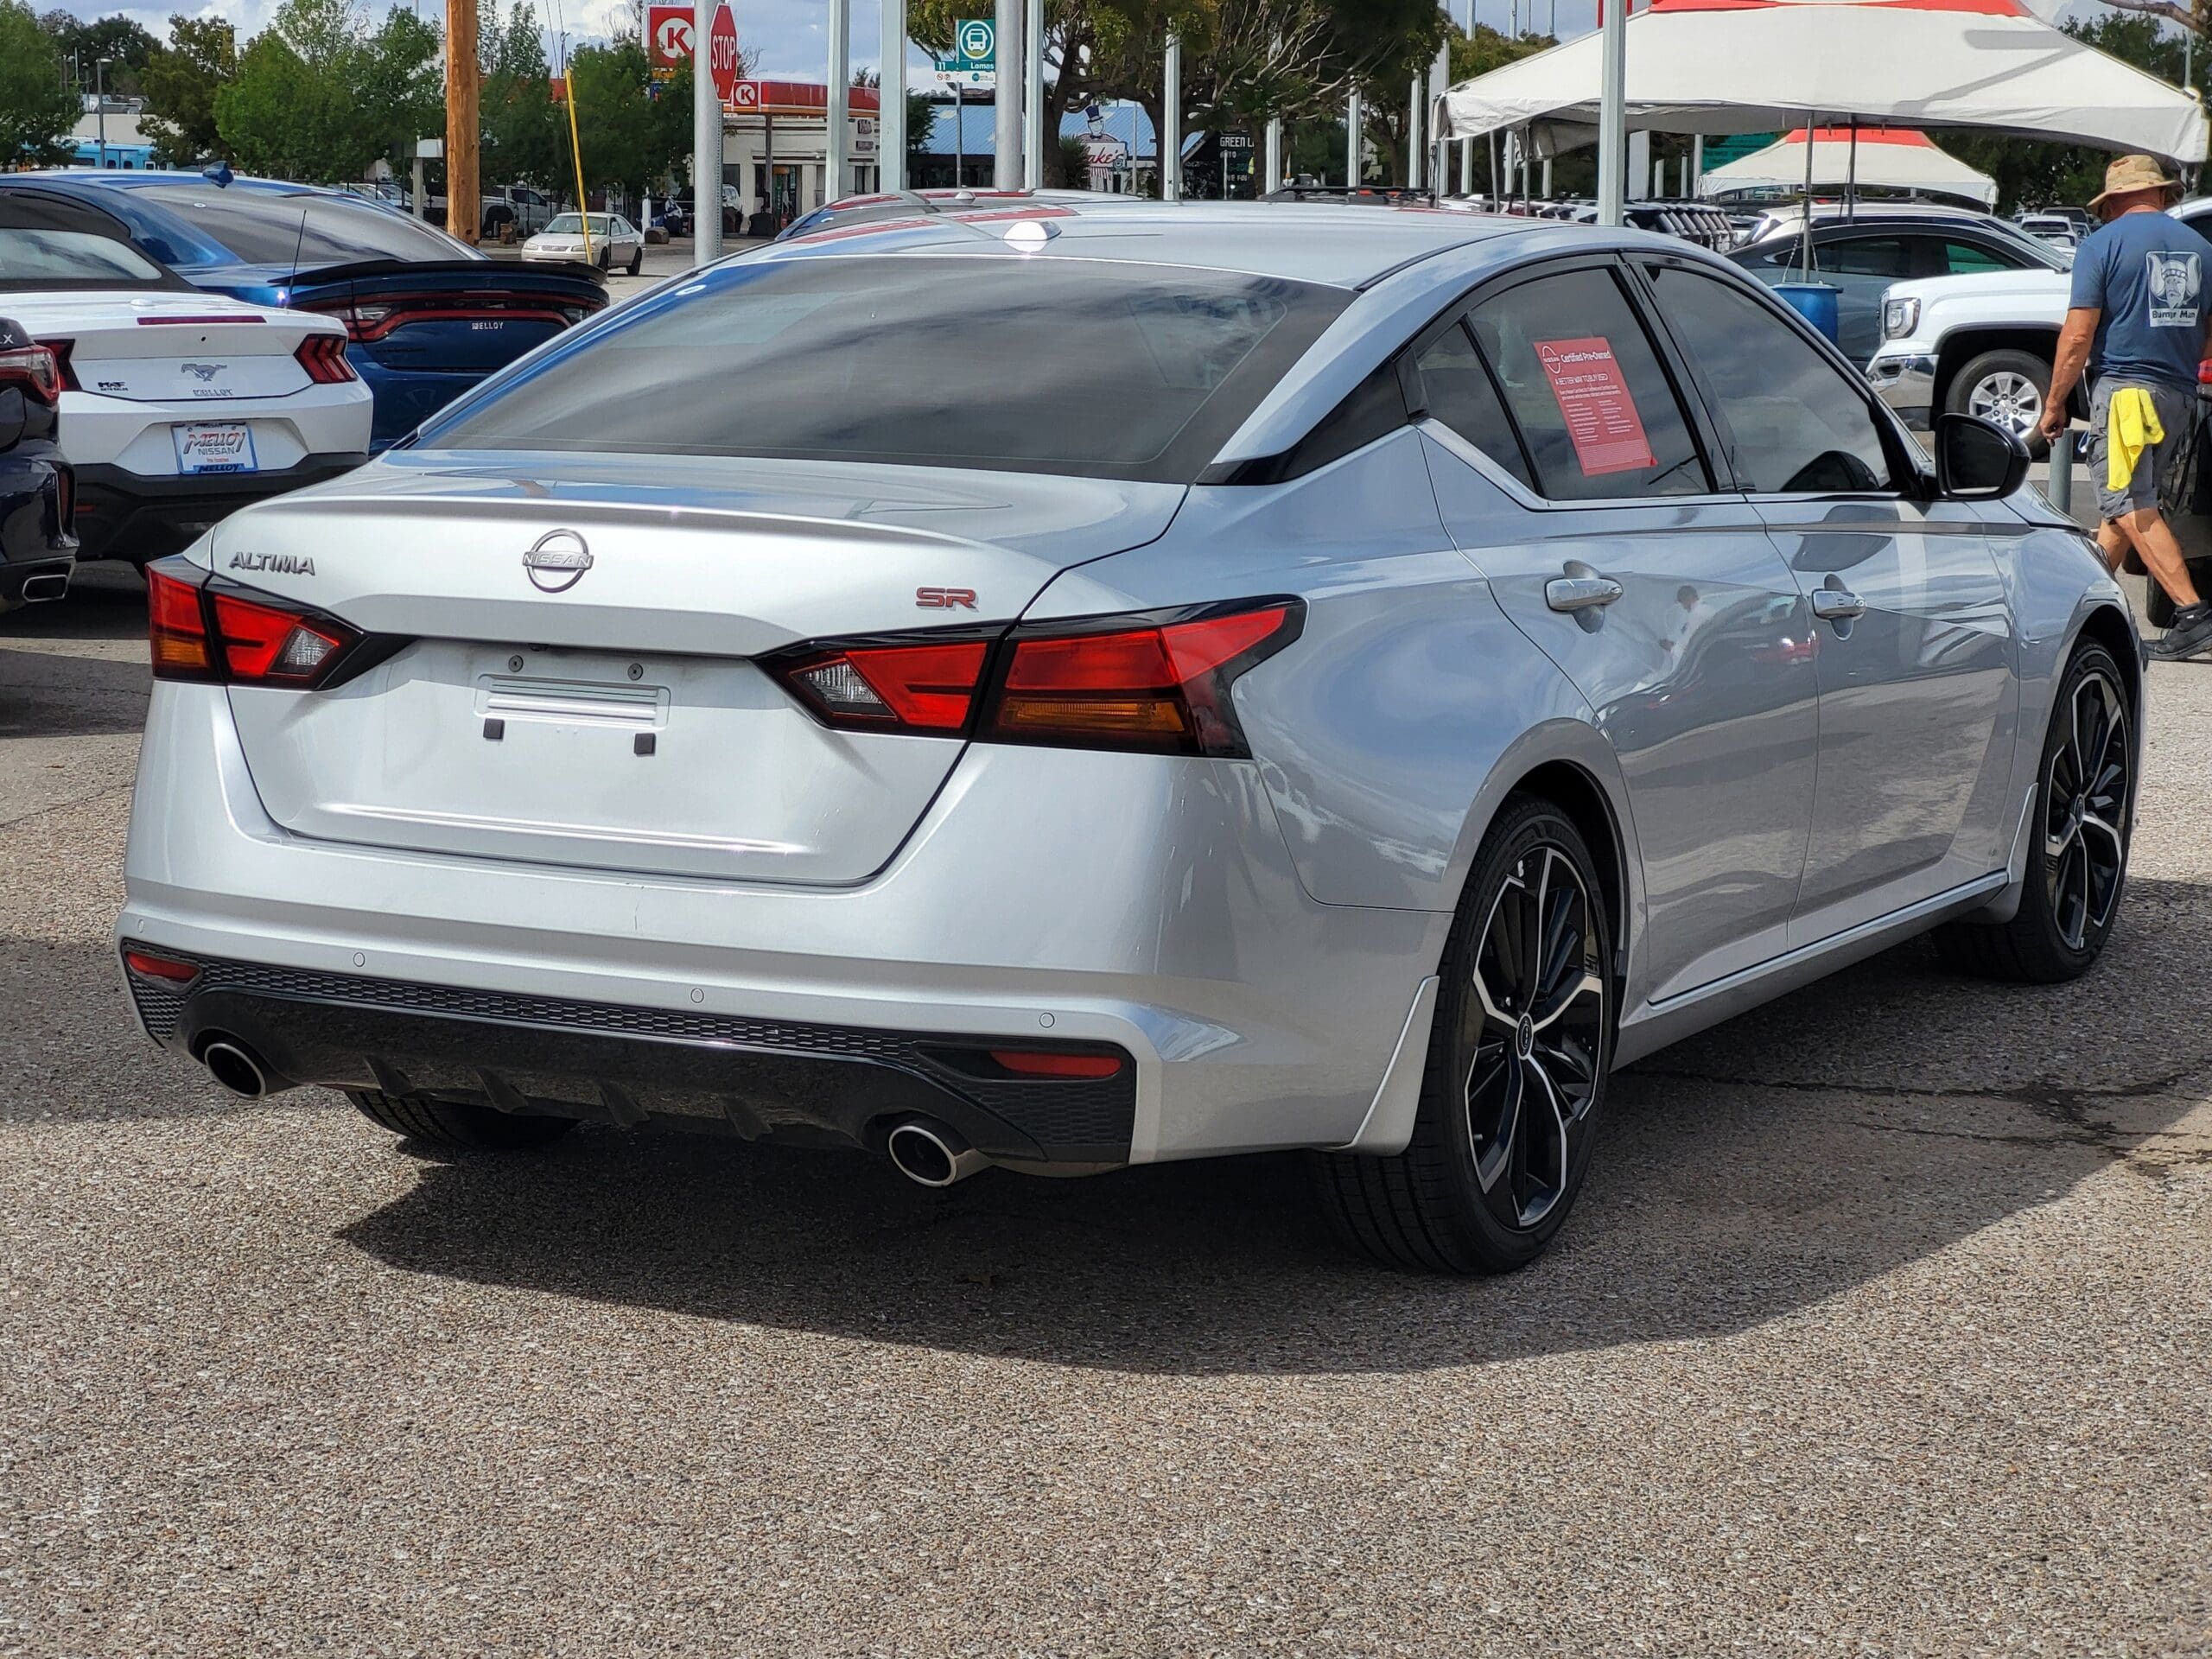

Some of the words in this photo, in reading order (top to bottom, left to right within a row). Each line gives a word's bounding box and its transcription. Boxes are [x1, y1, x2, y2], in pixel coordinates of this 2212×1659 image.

[667, 28, 691, 54] K
[712, 35, 735, 70] STOP
[741, 89, 753, 102] K
[1220, 137, 1245, 147] GREEN
[1560, 353, 1584, 363] Certified
[1583, 350, 1611, 361] Pre-Owned
[228, 551, 315, 576] ALTIMA
[524, 552, 593, 567] NISSAN
[916, 587, 976, 608] SR
